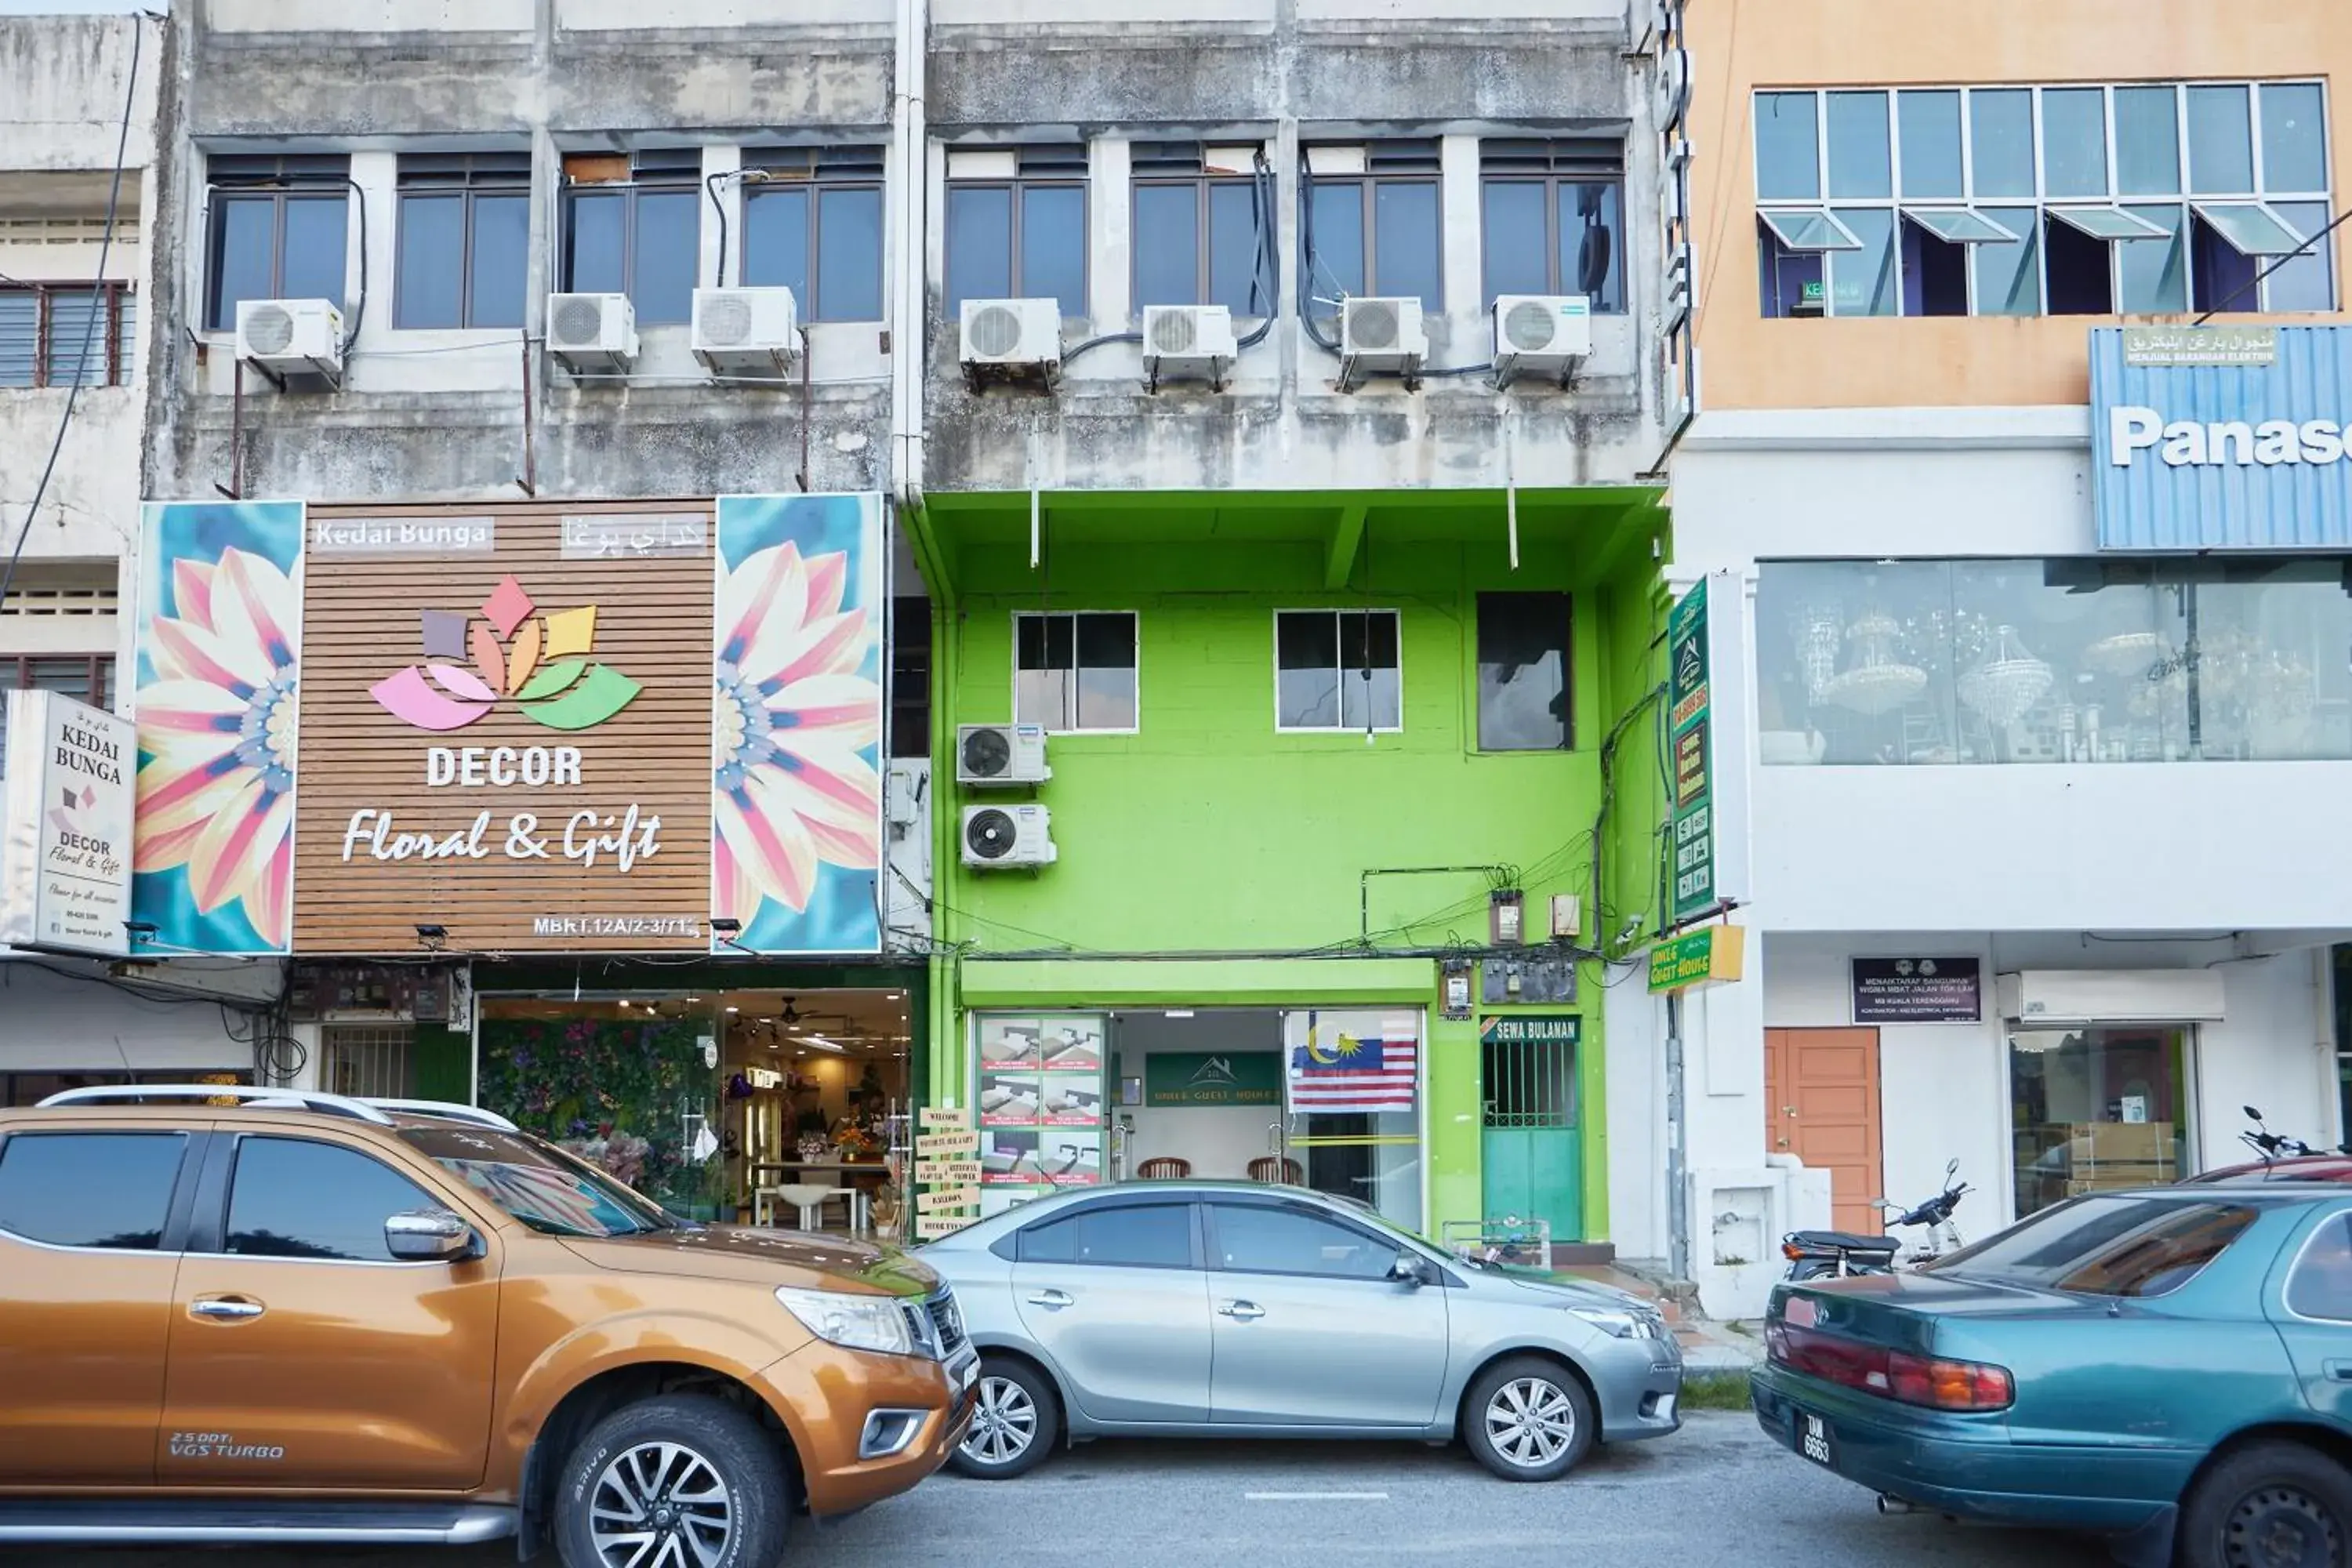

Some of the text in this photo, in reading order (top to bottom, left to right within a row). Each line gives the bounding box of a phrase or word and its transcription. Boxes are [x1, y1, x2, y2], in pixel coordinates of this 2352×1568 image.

[2110, 405, 2352, 466] Panas
[315, 523, 487, 549] Kedai Bunga
[62, 723, 119, 761] KEDAI
[56, 746, 122, 785] BUNGA
[427, 746, 583, 787] DECOR
[60, 831, 111, 855] DECOR
[342, 802, 662, 873] Floral & Gift
[49, 846, 84, 865] Floral
[85, 855, 96, 869] &
[1497, 1022, 1525, 1039] SEWA
[1528, 1022, 1576, 1039] BULANAN
[171, 1443, 285, 1458] VGS TURBO
